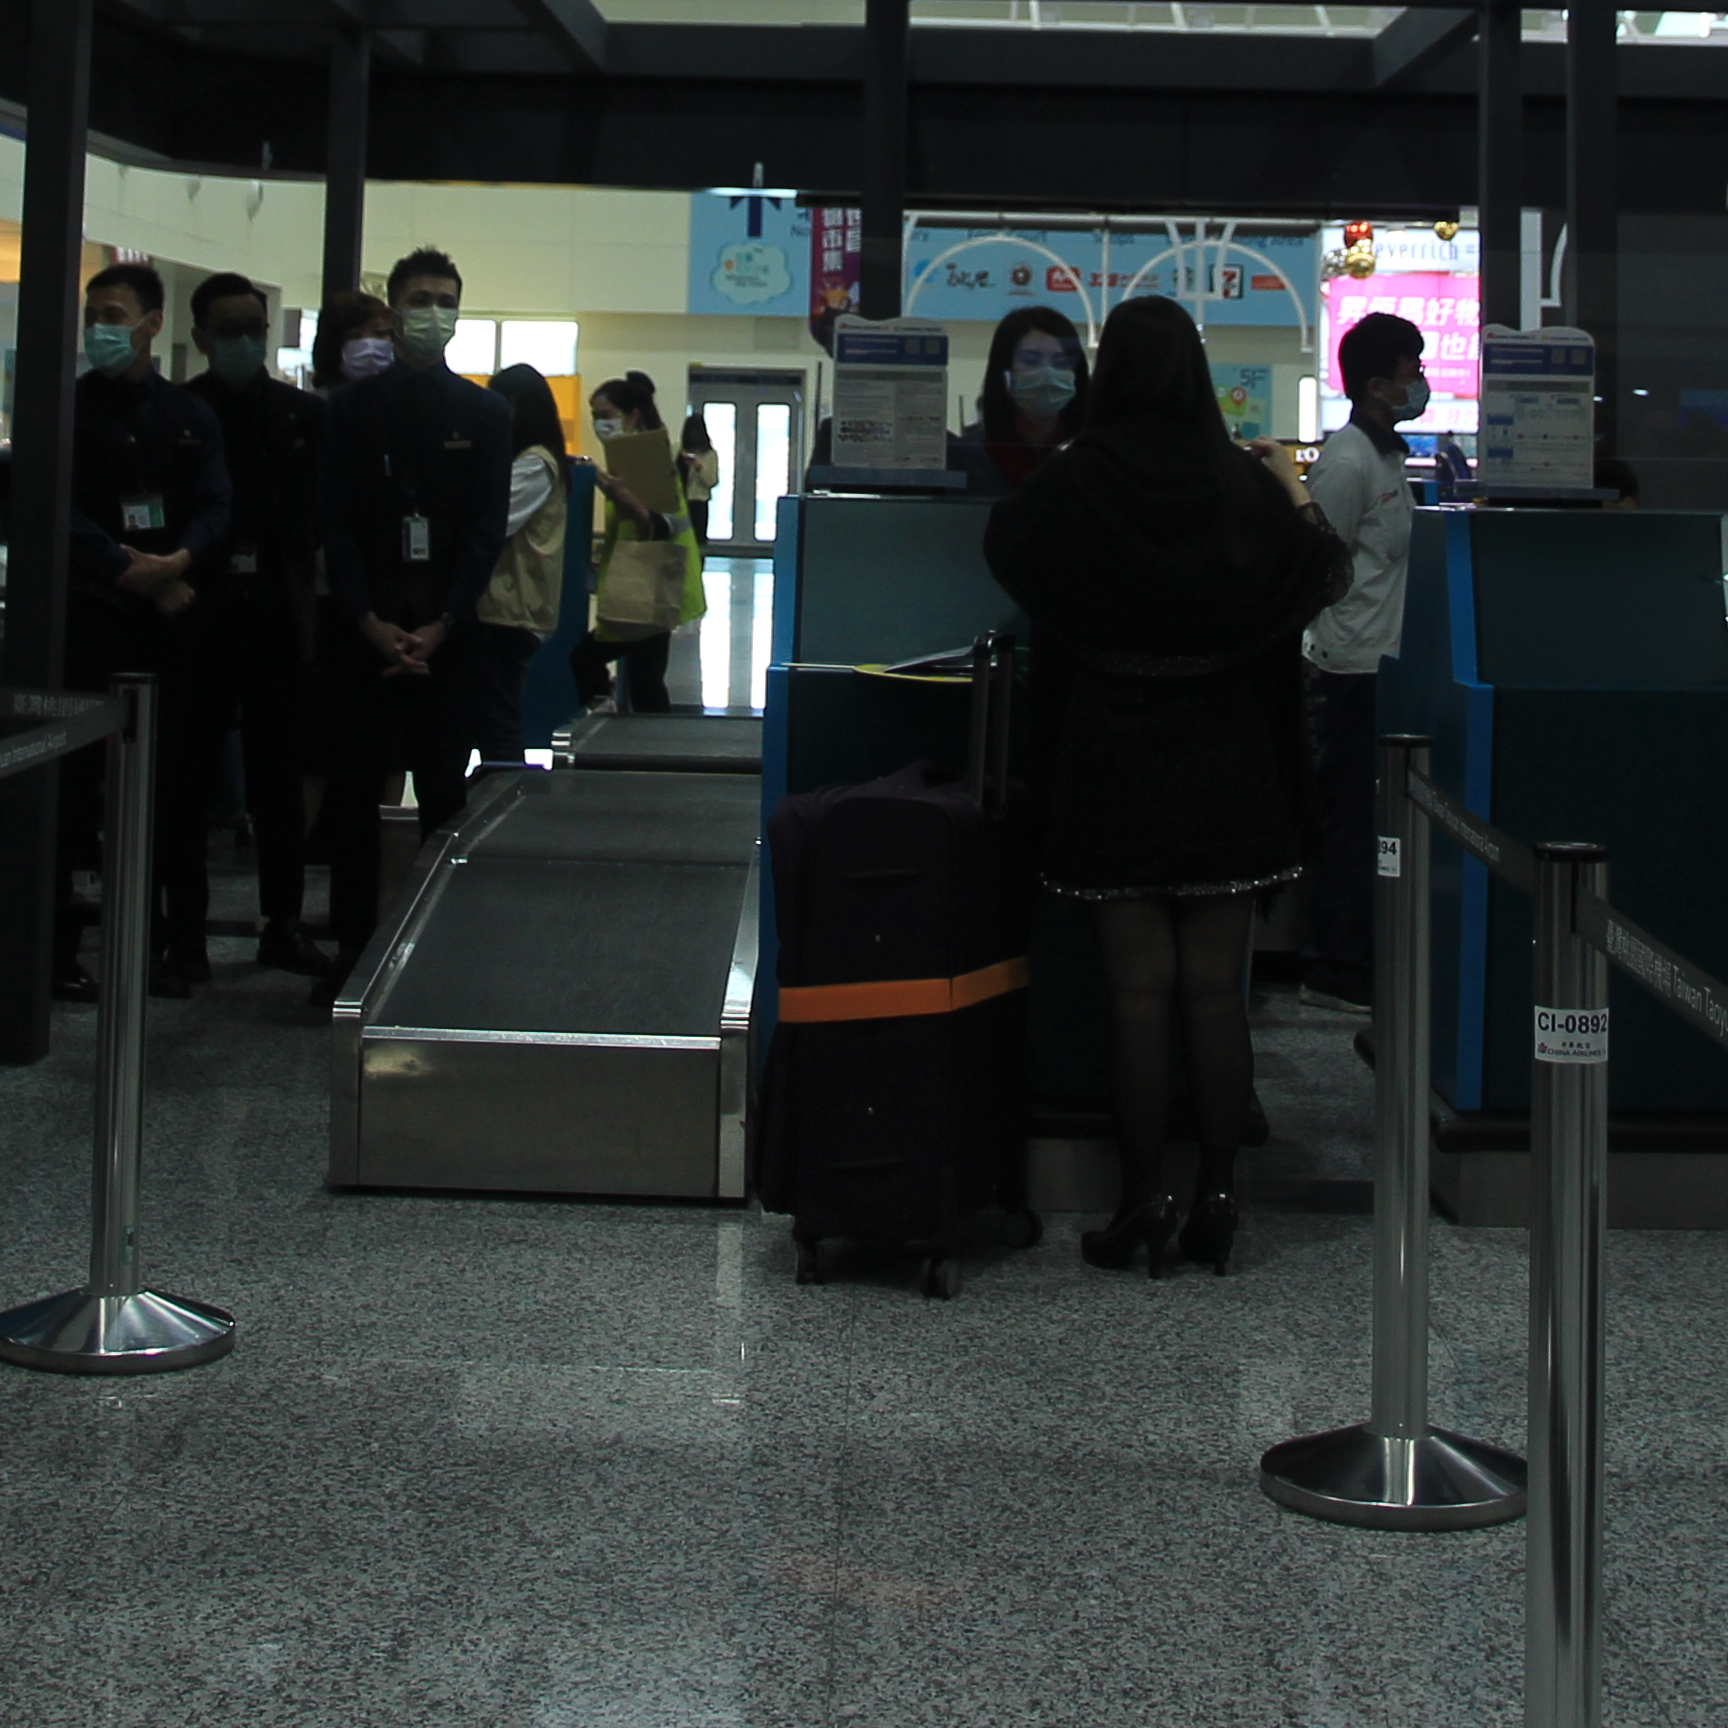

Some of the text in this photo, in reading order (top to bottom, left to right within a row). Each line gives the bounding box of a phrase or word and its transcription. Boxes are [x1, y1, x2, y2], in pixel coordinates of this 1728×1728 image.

[1374, 238, 1459, 262] everrich
[1672, 964, 1703, 1013] Taiwan
[1537, 1011, 1608, 1034] CI-0892
